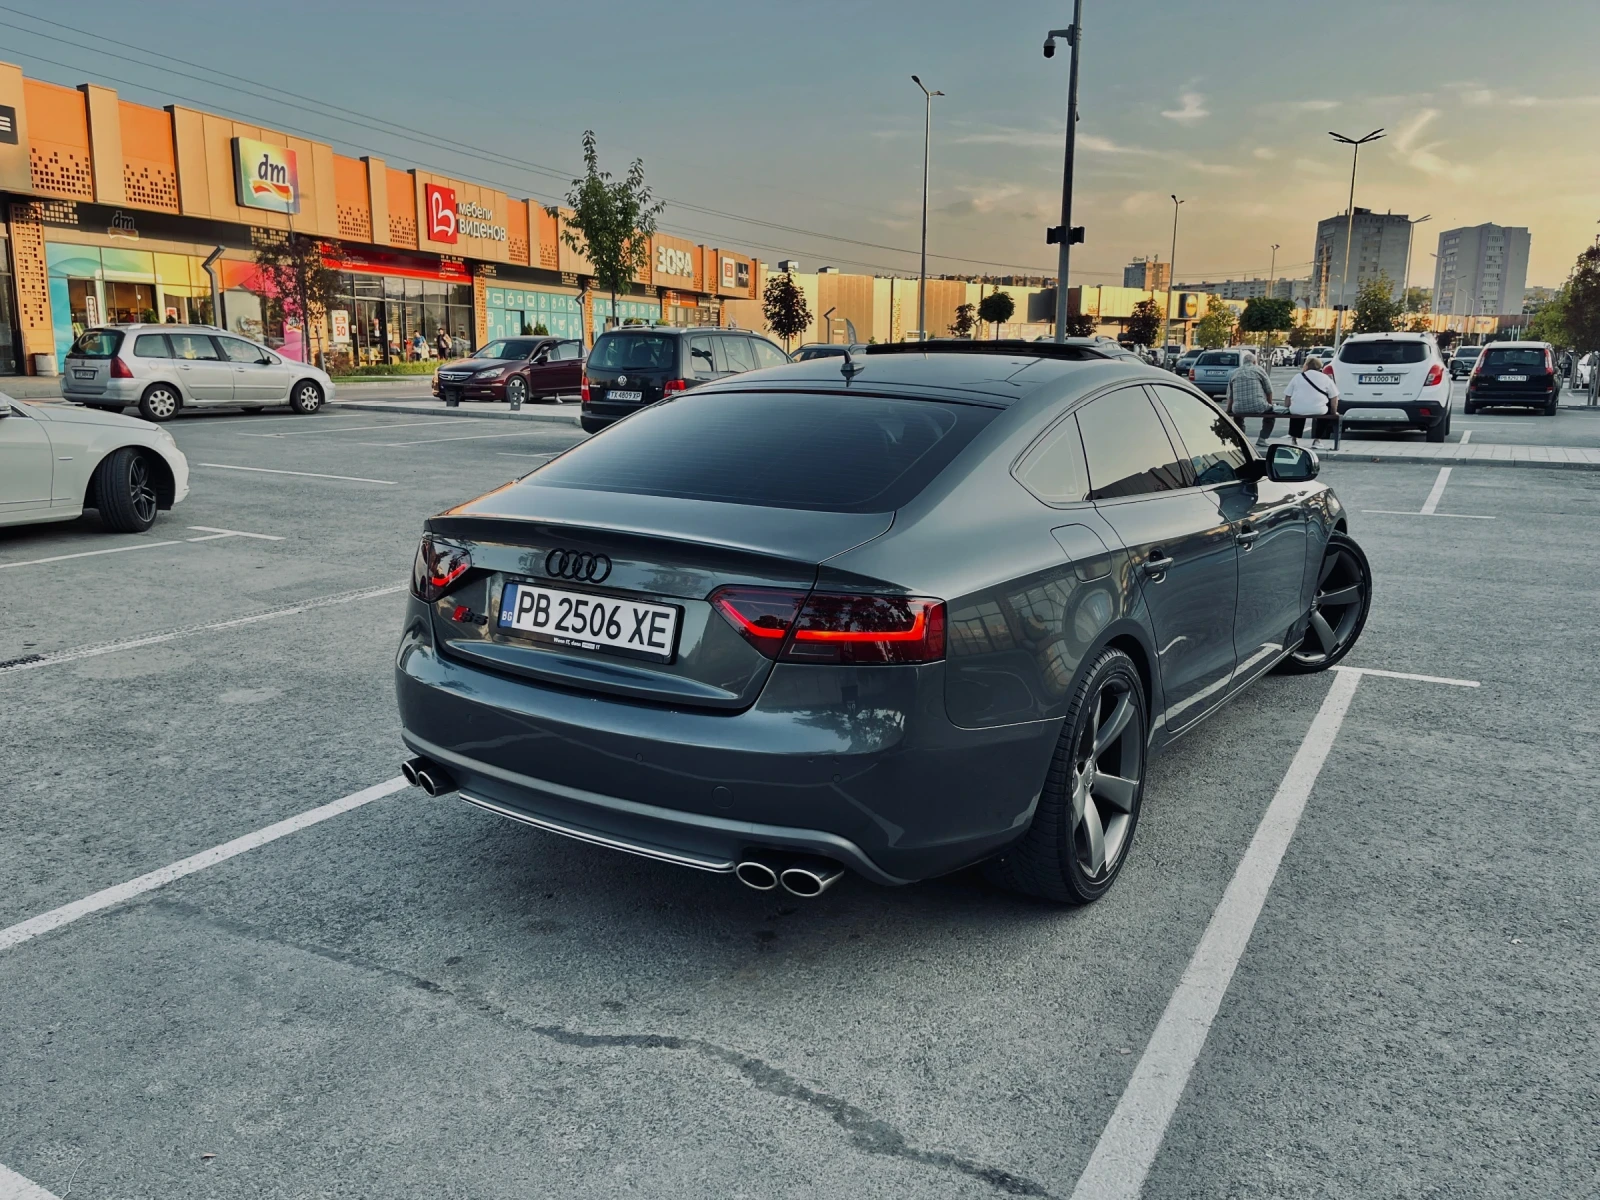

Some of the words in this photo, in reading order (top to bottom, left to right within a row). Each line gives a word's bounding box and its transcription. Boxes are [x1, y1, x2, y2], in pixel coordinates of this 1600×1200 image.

[258, 153, 286, 184] dm
[112, 210, 135, 229] dm
[656, 245, 694, 278] ЗОРА
[501, 610, 513, 622] BG
[516, 590, 550, 628] PB
[555, 597, 621, 640] 2506
[628, 607, 670, 649] XE
